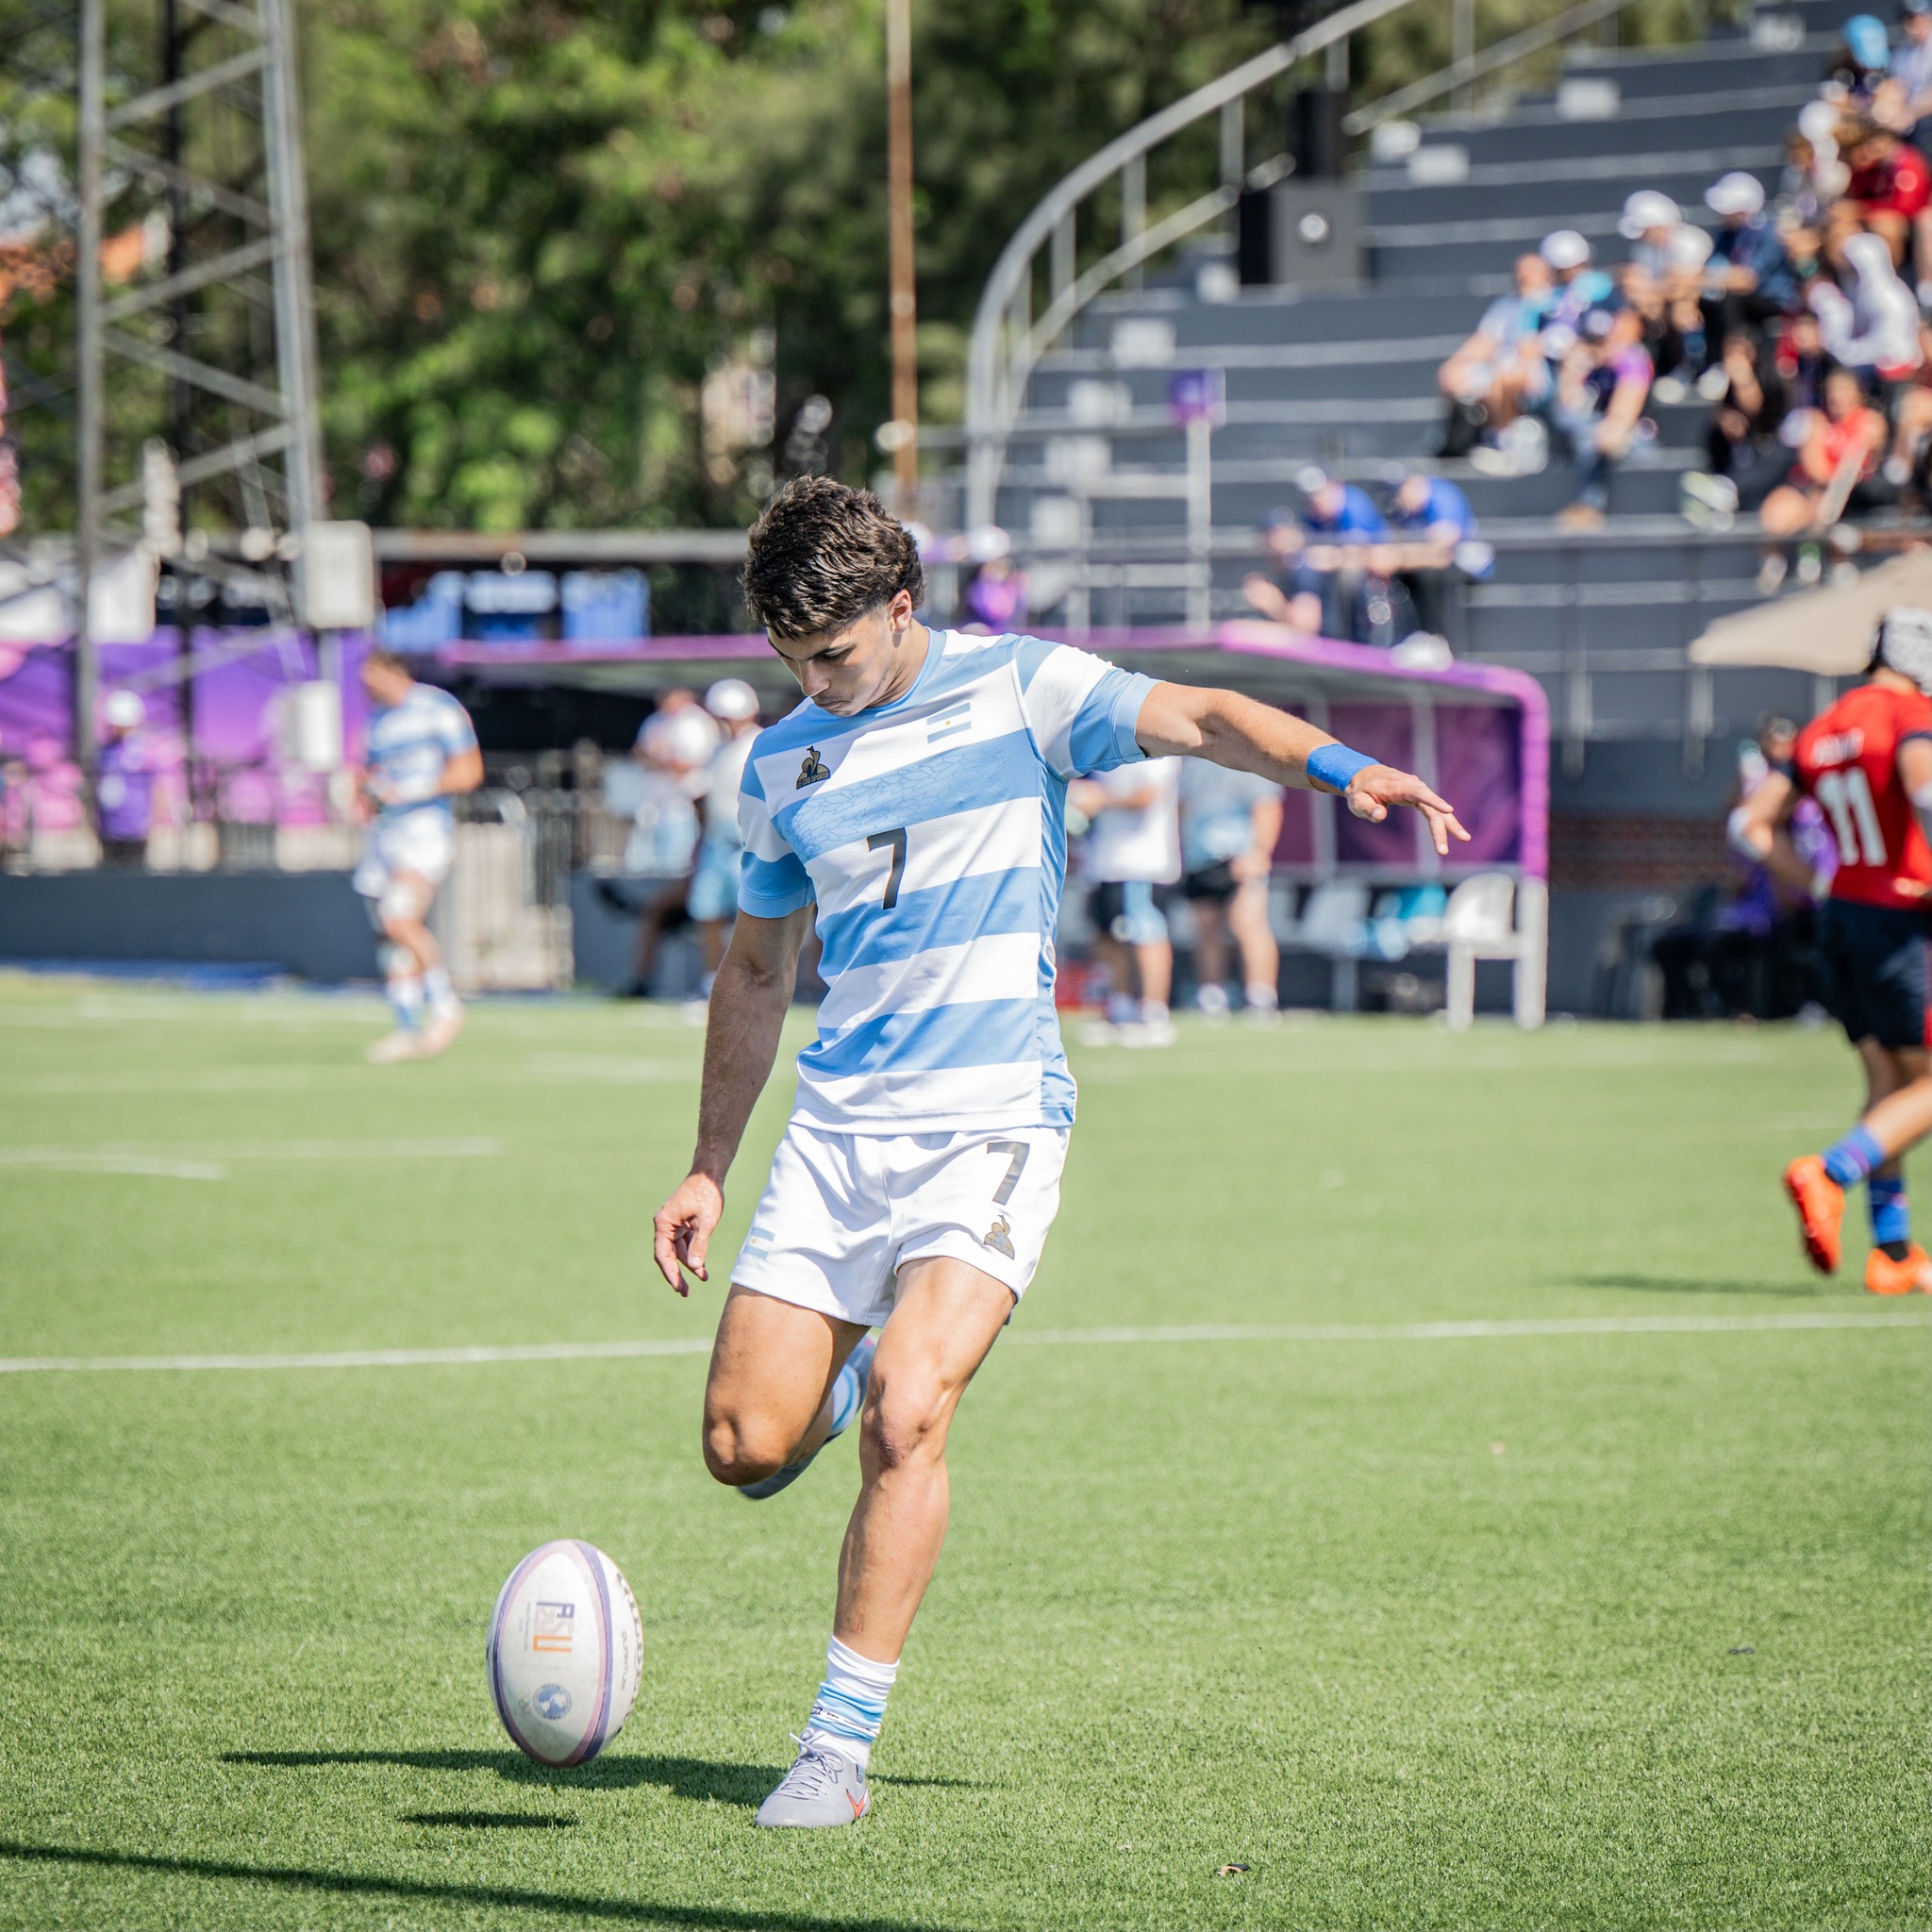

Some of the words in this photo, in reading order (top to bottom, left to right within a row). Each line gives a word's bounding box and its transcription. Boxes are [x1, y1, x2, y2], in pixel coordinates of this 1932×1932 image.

[1815, 767, 1888, 866] 11
[866, 826, 908, 910] 7
[987, 1141, 1030, 1206] 7
